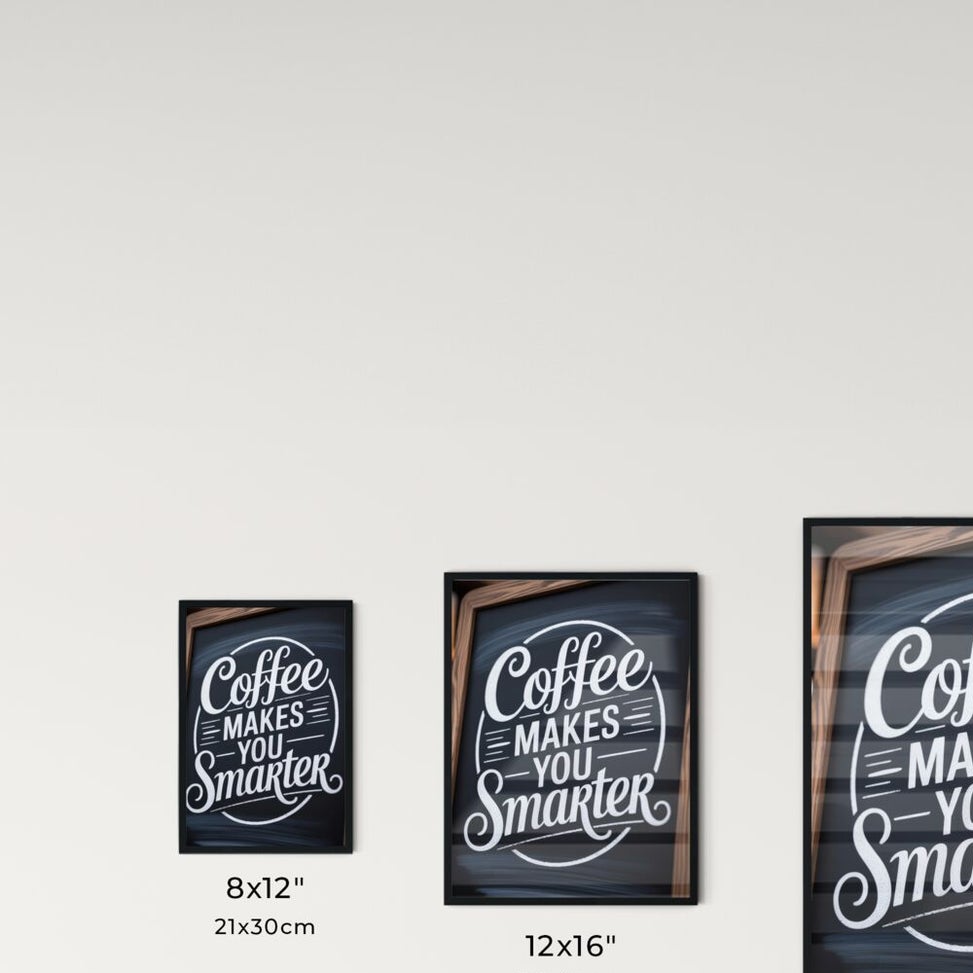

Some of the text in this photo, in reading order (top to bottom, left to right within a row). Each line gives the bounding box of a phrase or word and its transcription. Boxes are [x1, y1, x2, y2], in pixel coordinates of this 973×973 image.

[201, 646, 330, 714] Coffee
[485, 632, 653, 722] Coffee
[224, 701, 304, 740] MAKES
[514, 704, 620, 756] MAKES
[238, 734, 283, 764] YOU
[533, 747, 593, 787] YOU
